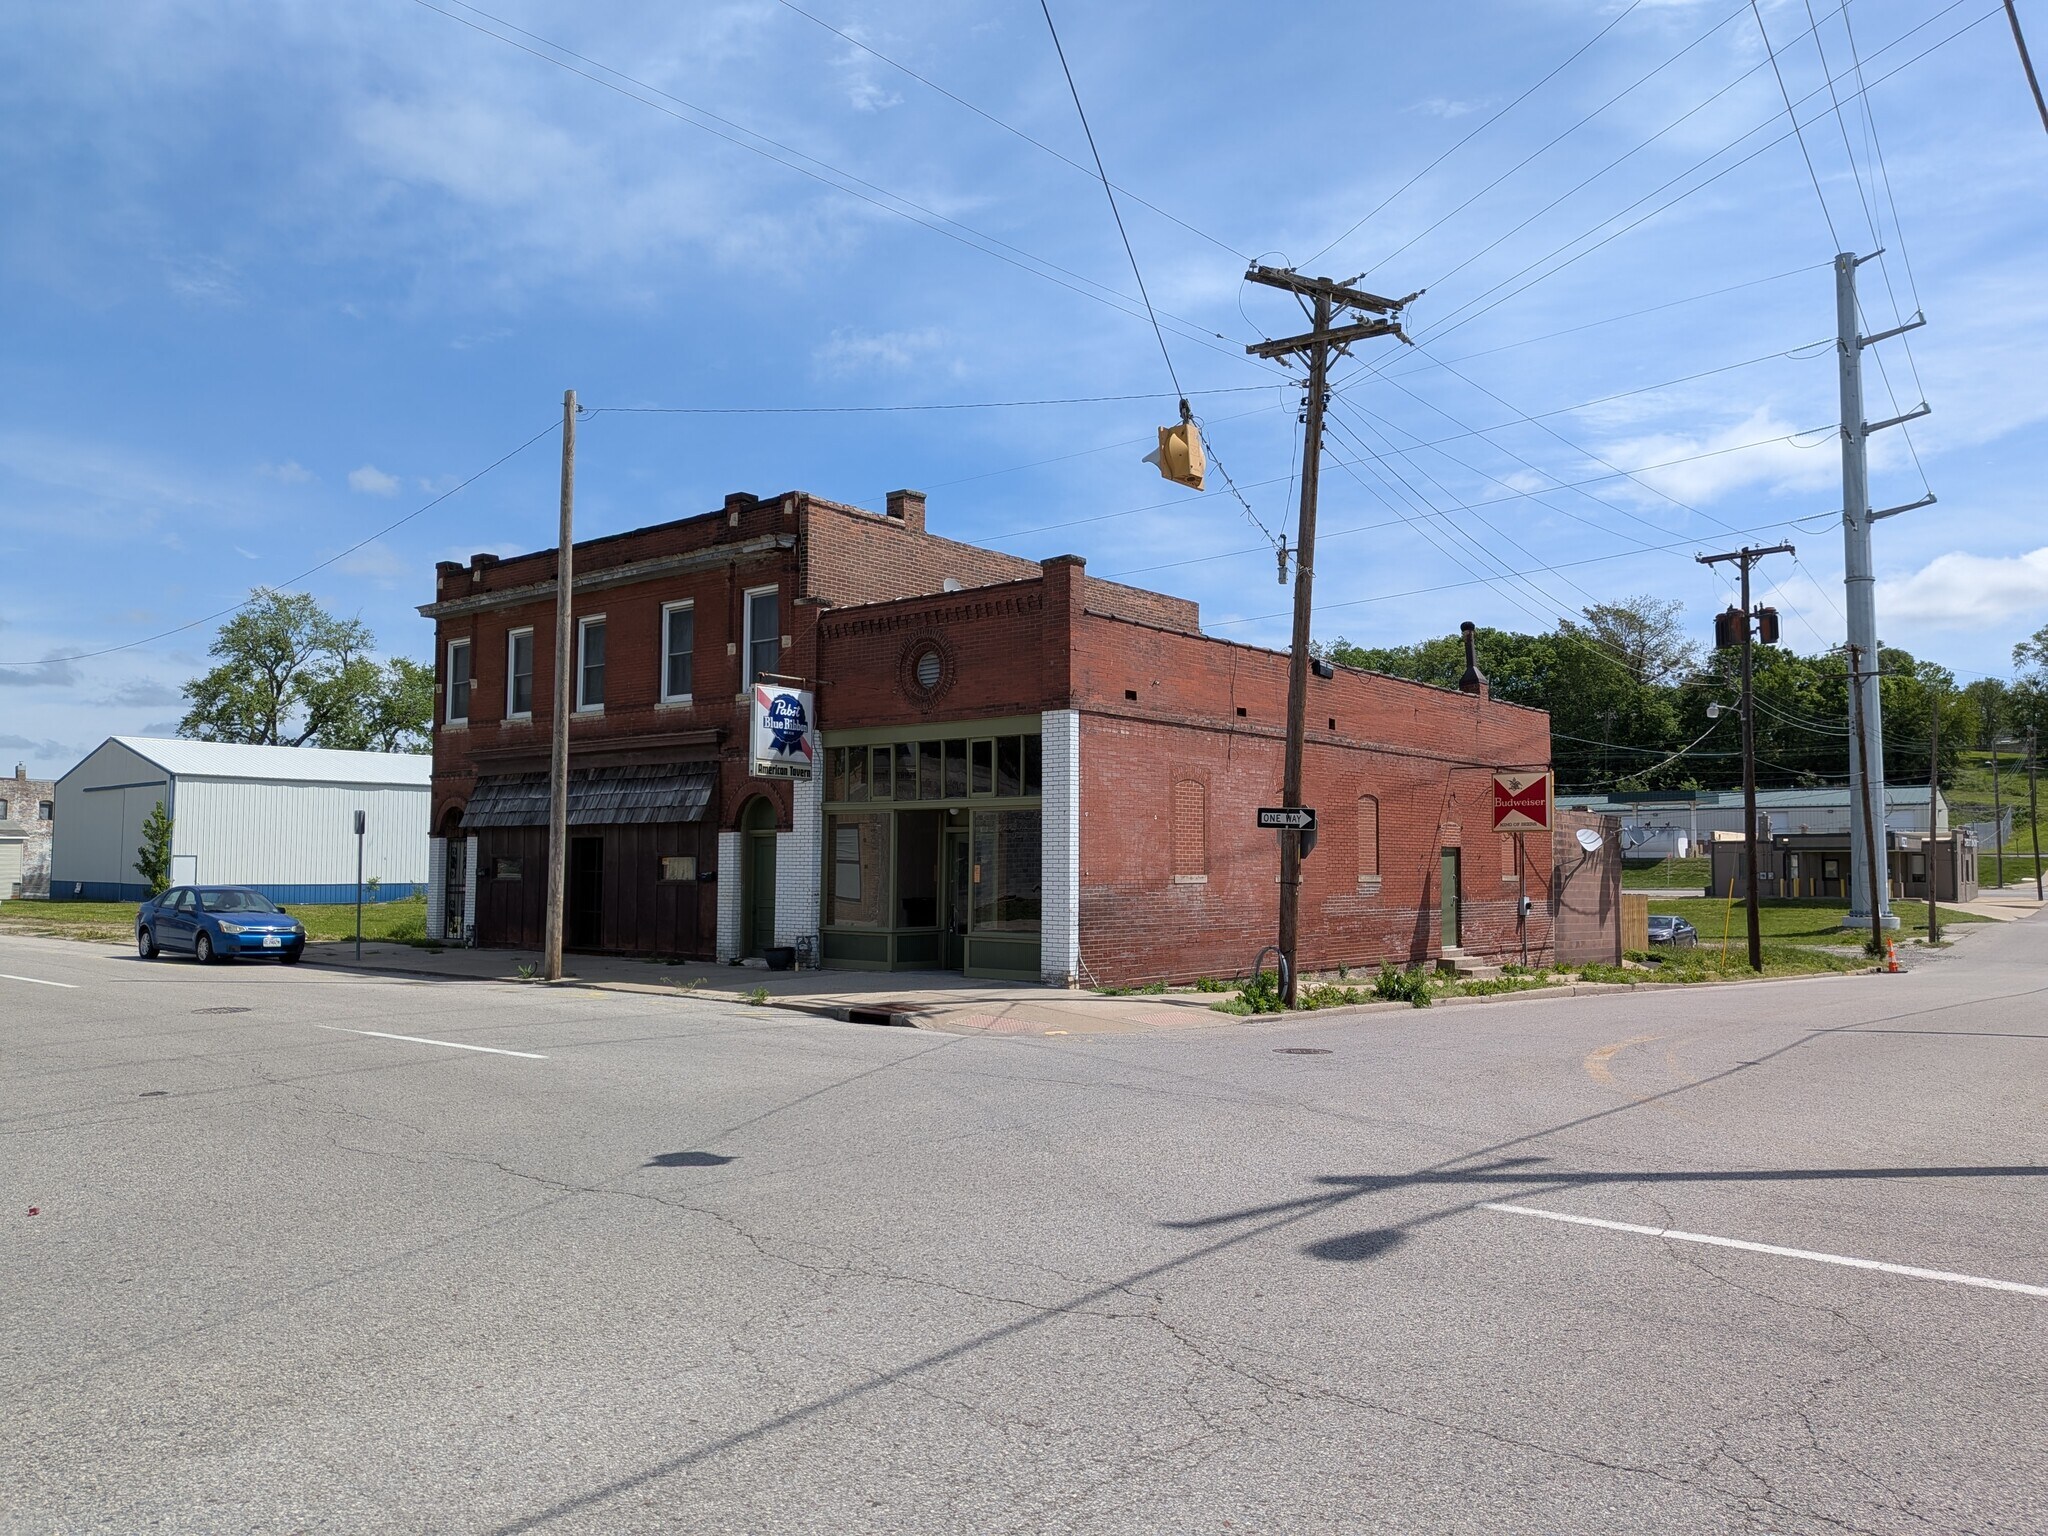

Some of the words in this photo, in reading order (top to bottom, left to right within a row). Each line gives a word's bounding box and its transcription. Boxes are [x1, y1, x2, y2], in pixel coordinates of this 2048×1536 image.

[774, 700, 800, 716] Pabst
[764, 716, 784, 729] Blue
[784, 718, 808, 732] Ribbon
[758, 764, 788, 776] American
[790, 766, 810, 778] Tavern
[1495, 798, 1546, 807] Budweiser
[1264, 814, 1281, 822] ONE
[1286, 814, 1302, 822] WAY
